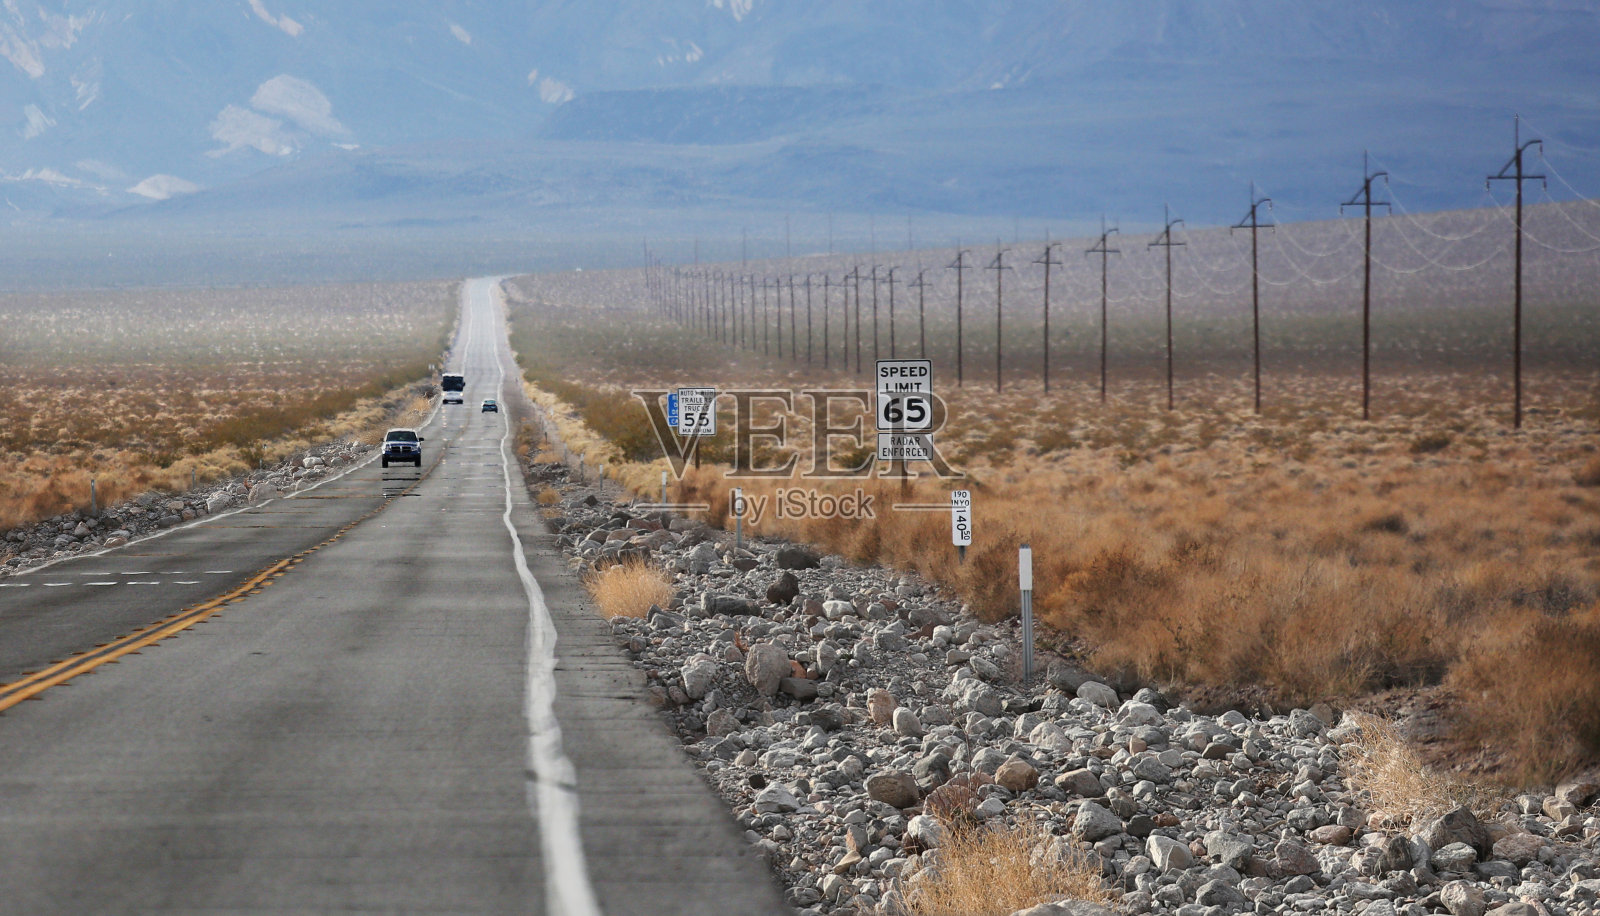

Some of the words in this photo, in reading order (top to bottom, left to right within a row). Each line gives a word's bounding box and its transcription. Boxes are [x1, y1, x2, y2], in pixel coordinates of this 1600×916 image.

[880, 366, 928, 378] SPEED
[885, 382, 922, 393] LIMIT
[883, 397, 926, 423] 65
[684, 412, 709, 427] 55
[890, 436, 921, 445] RADAR
[882, 447, 928, 457] ENFORCED
[951, 499, 970, 507] INYO
[956, 509, 967, 531] 140
[963, 530, 971, 541] 50
